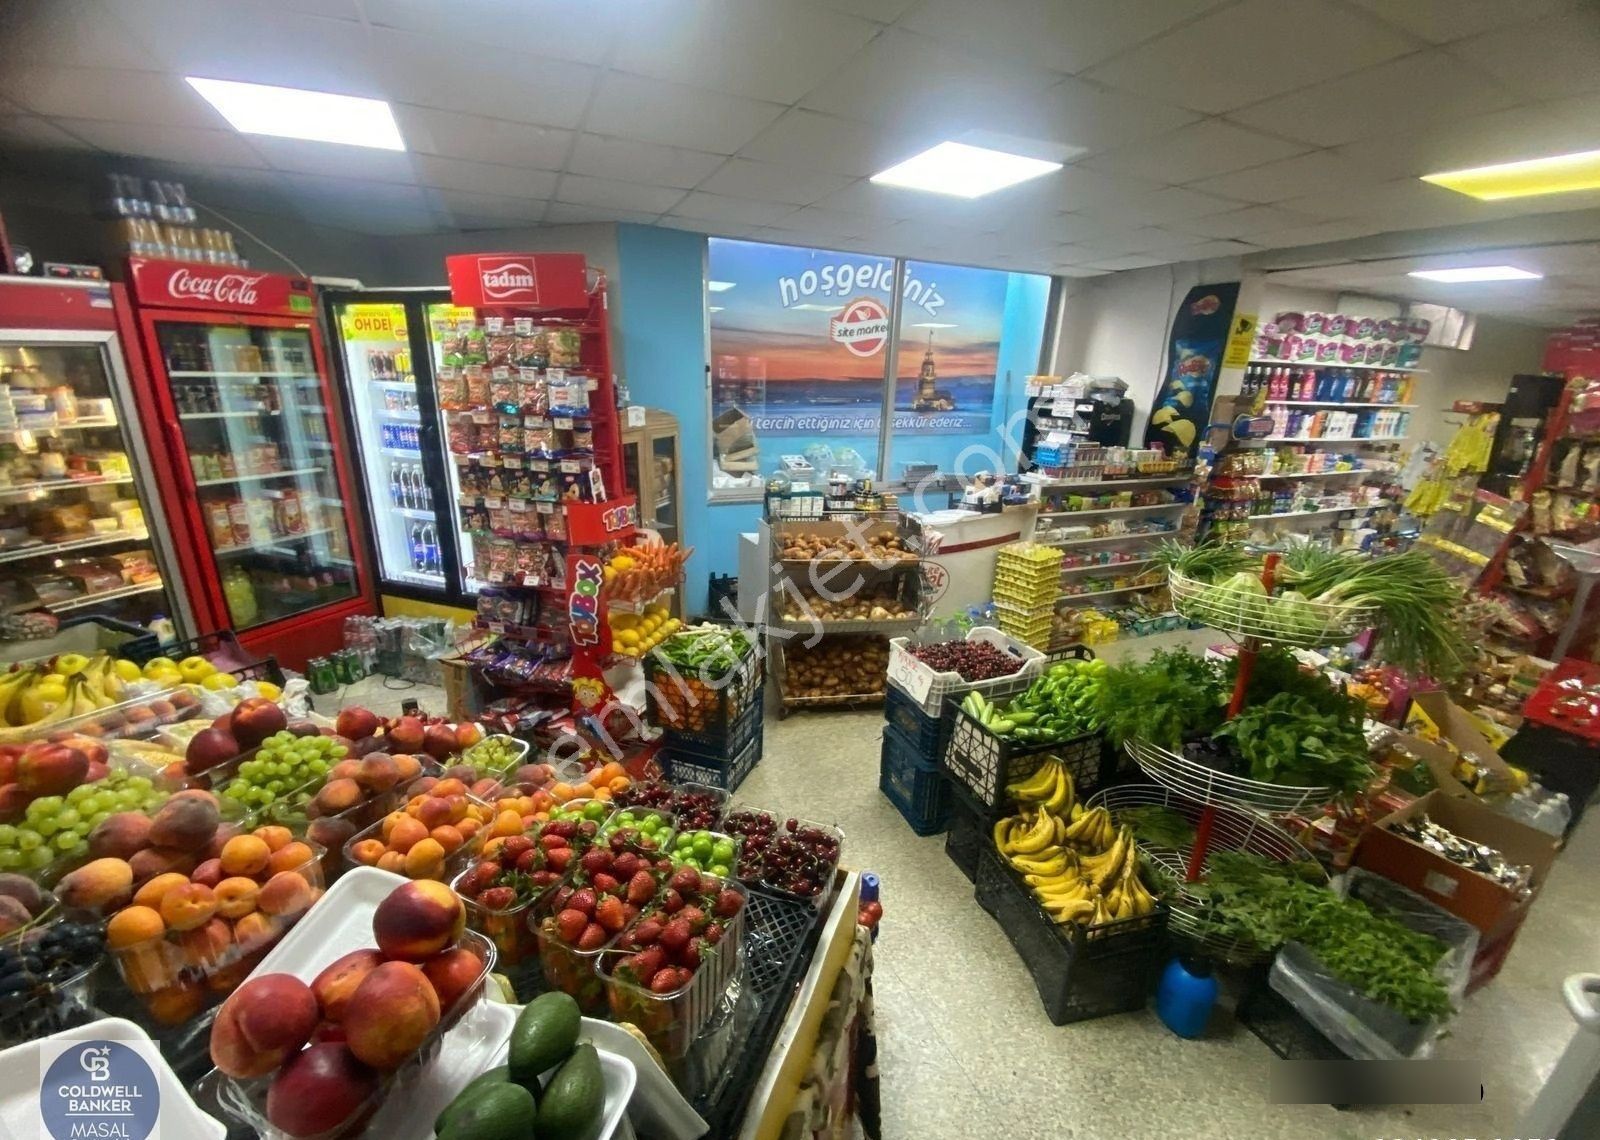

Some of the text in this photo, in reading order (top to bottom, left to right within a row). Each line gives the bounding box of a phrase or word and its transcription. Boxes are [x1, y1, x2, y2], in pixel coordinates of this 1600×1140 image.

[168, 268, 268, 304] Coca-Cola
[482, 271, 534, 287] tadım
[354, 318, 371, 331] OH
[856, 324, 889, 337] marke
